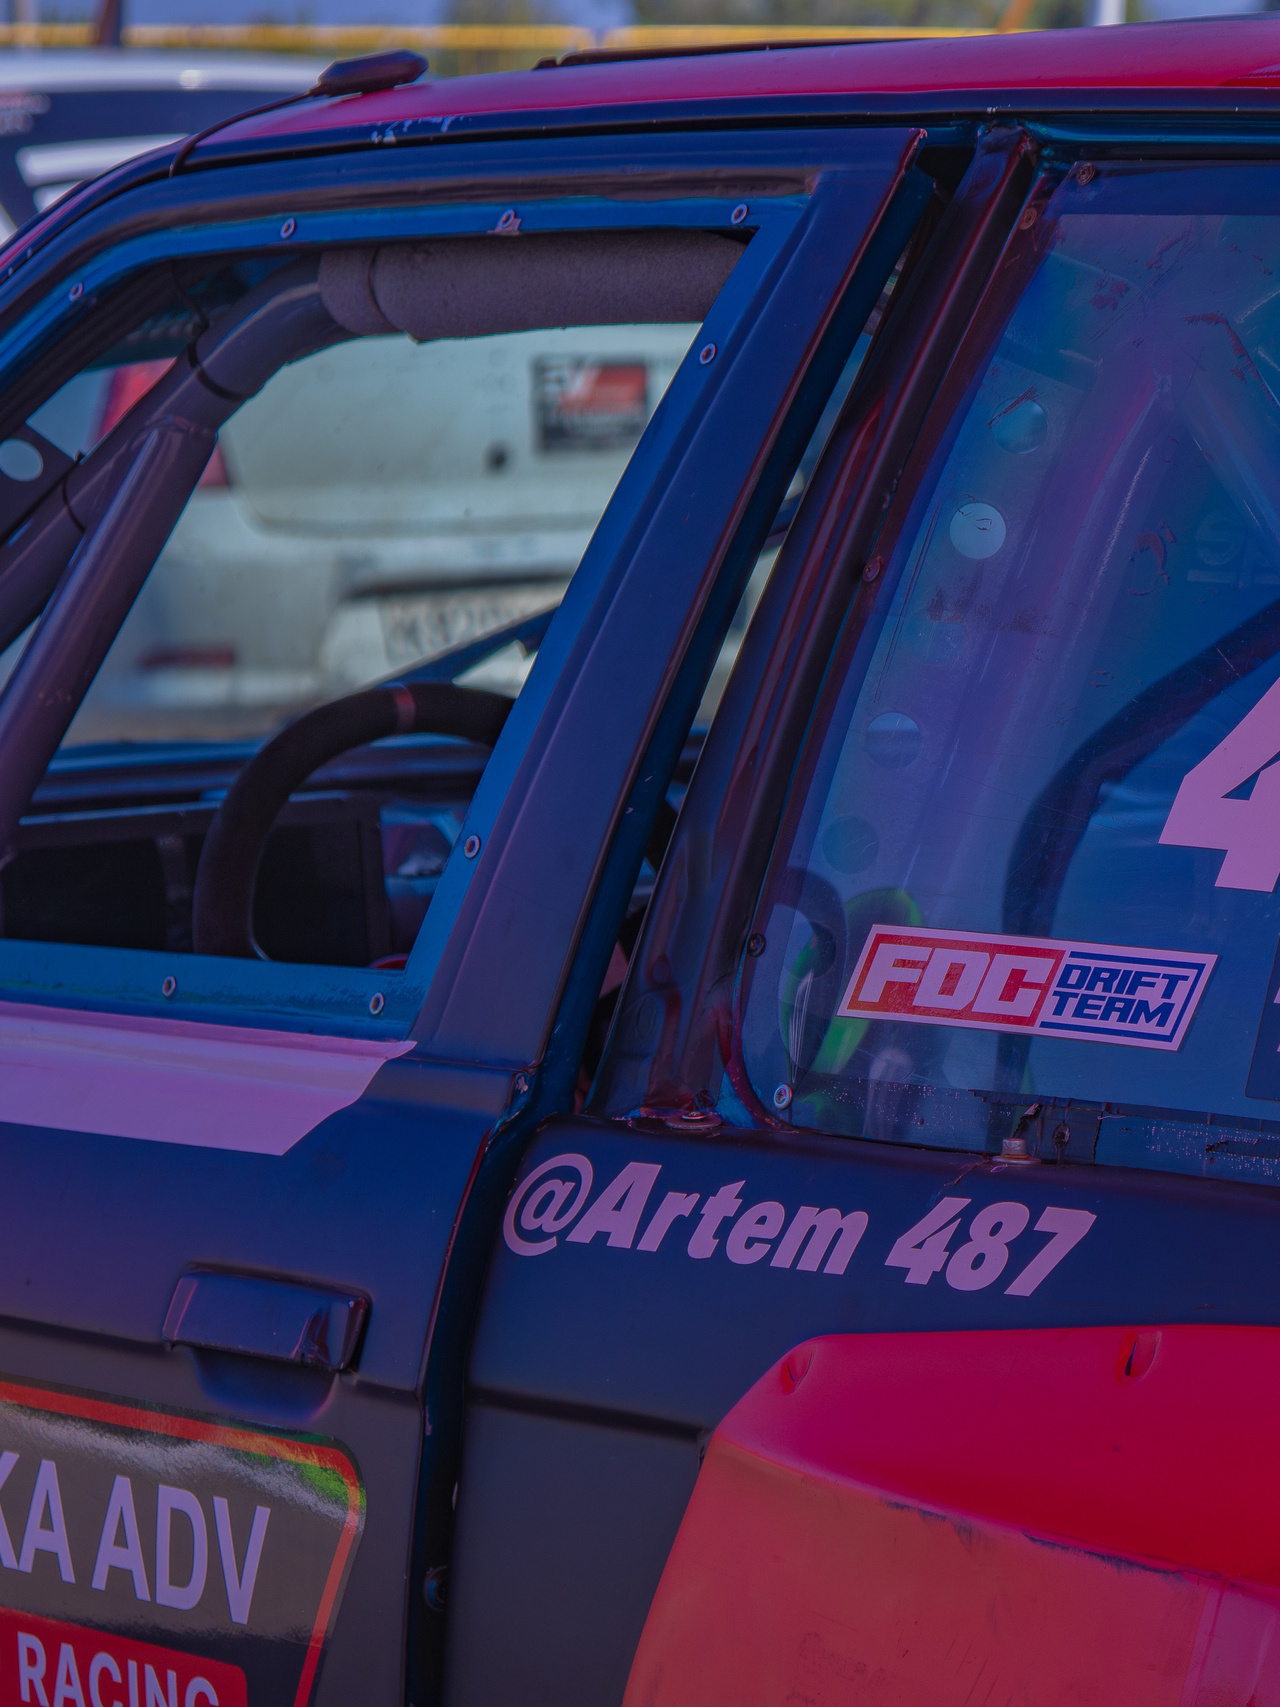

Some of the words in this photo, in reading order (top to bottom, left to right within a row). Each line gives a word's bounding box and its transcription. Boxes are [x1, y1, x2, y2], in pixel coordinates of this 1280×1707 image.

[857, 943, 1056, 1017] FOC
[1050, 991, 1176, 1028] TEAM
[1056, 963, 1190, 1000] DRIFT
[502, 1153, 869, 1275] @Artem
[884, 1196, 1097, 1297] 487
[91, 1474, 271, 1625] ADV
